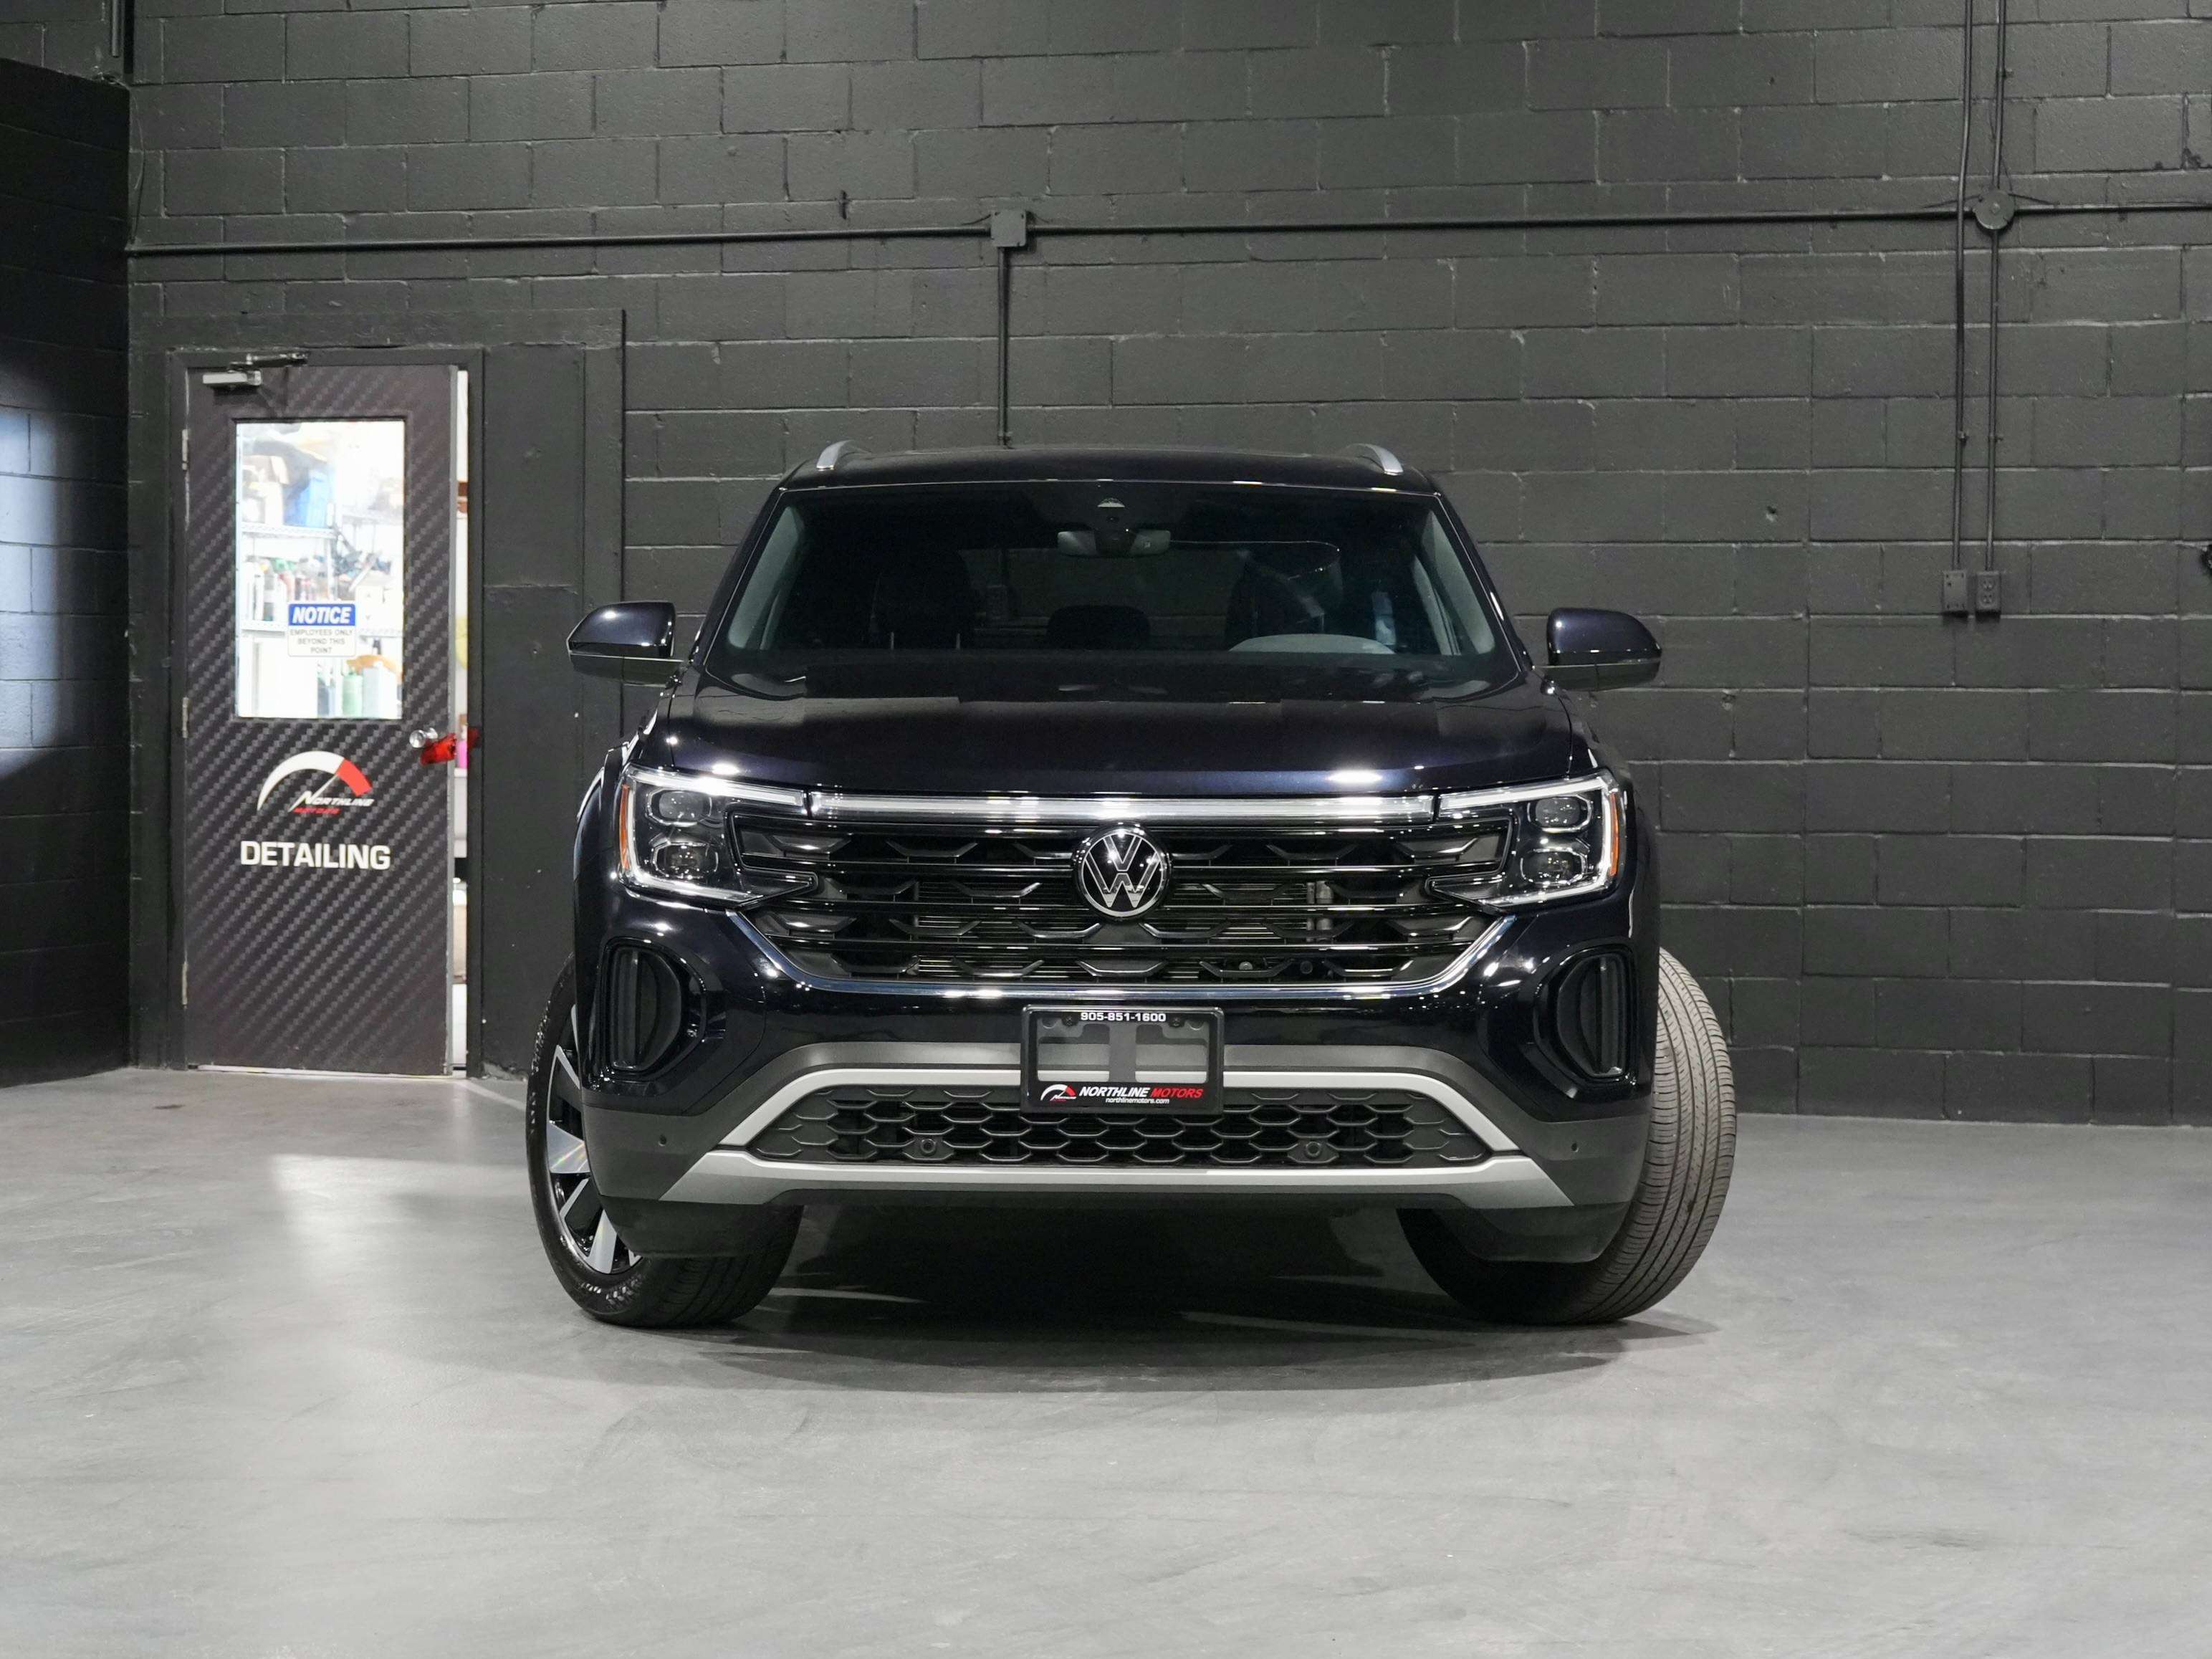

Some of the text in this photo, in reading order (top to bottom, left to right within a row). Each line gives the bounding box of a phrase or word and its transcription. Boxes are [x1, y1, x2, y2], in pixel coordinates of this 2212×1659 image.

[292, 606, 352, 624] NOTICE
[240, 841, 391, 870] DETAILING
[1081, 1012, 1167, 1022] 905-851-1600
[1079, 1086, 1204, 1098] NORTHLINE MOTORS
